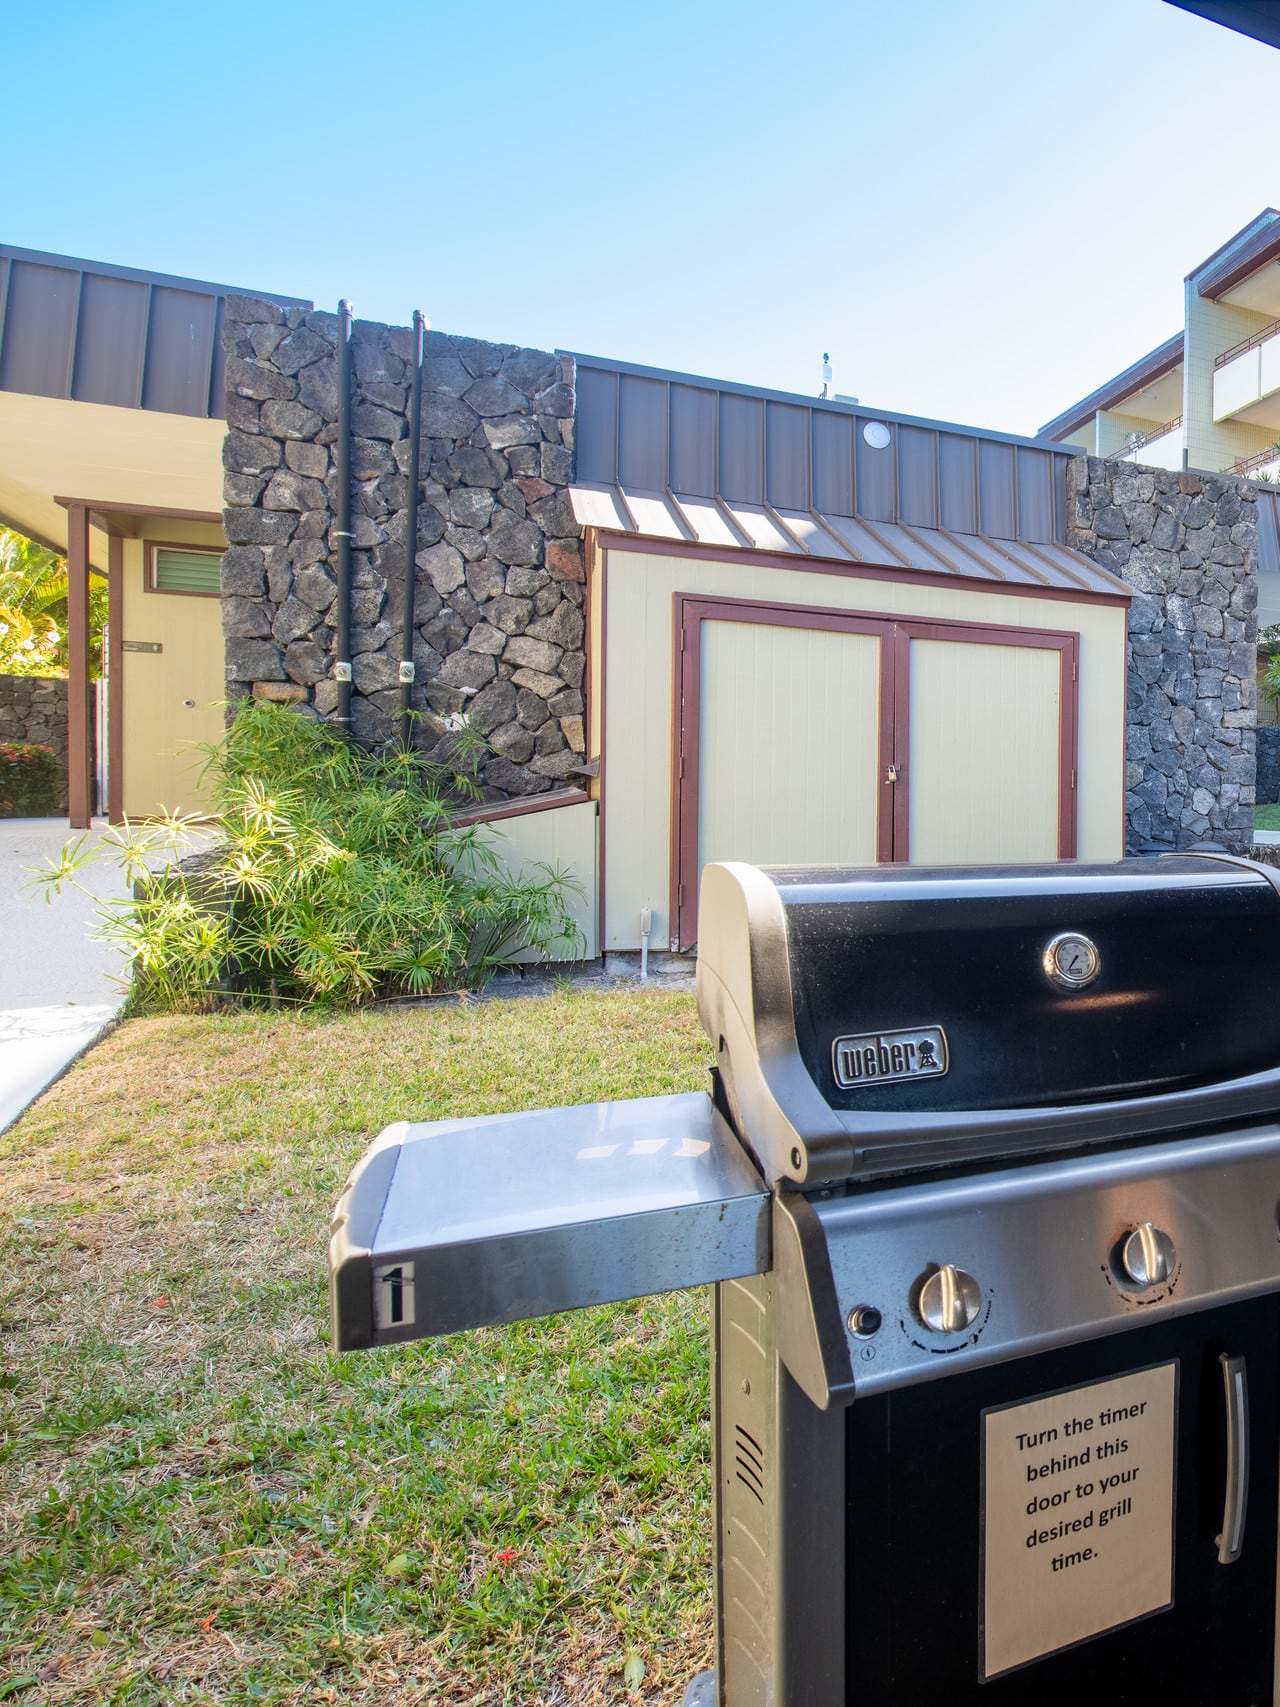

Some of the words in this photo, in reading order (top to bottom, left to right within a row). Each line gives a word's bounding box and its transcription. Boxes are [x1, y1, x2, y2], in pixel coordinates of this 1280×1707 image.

[842, 1036, 916, 1079] weber
[382, 1267, 403, 1323] 1
[1015, 1432, 1058, 1452] Turn
[1063, 1417, 1094, 1438] the
[1099, 1401, 1148, 1427] timer
[1026, 1447, 1091, 1482] behind
[1096, 1437, 1129, 1461] this
[1026, 1491, 1070, 1515] door
[1075, 1483, 1094, 1499] to
[1099, 1468, 1140, 1495] your
[1025, 1511, 1093, 1549] desired
[1099, 1497, 1132, 1526] grill
[1051, 1548, 1098, 1573] time.
